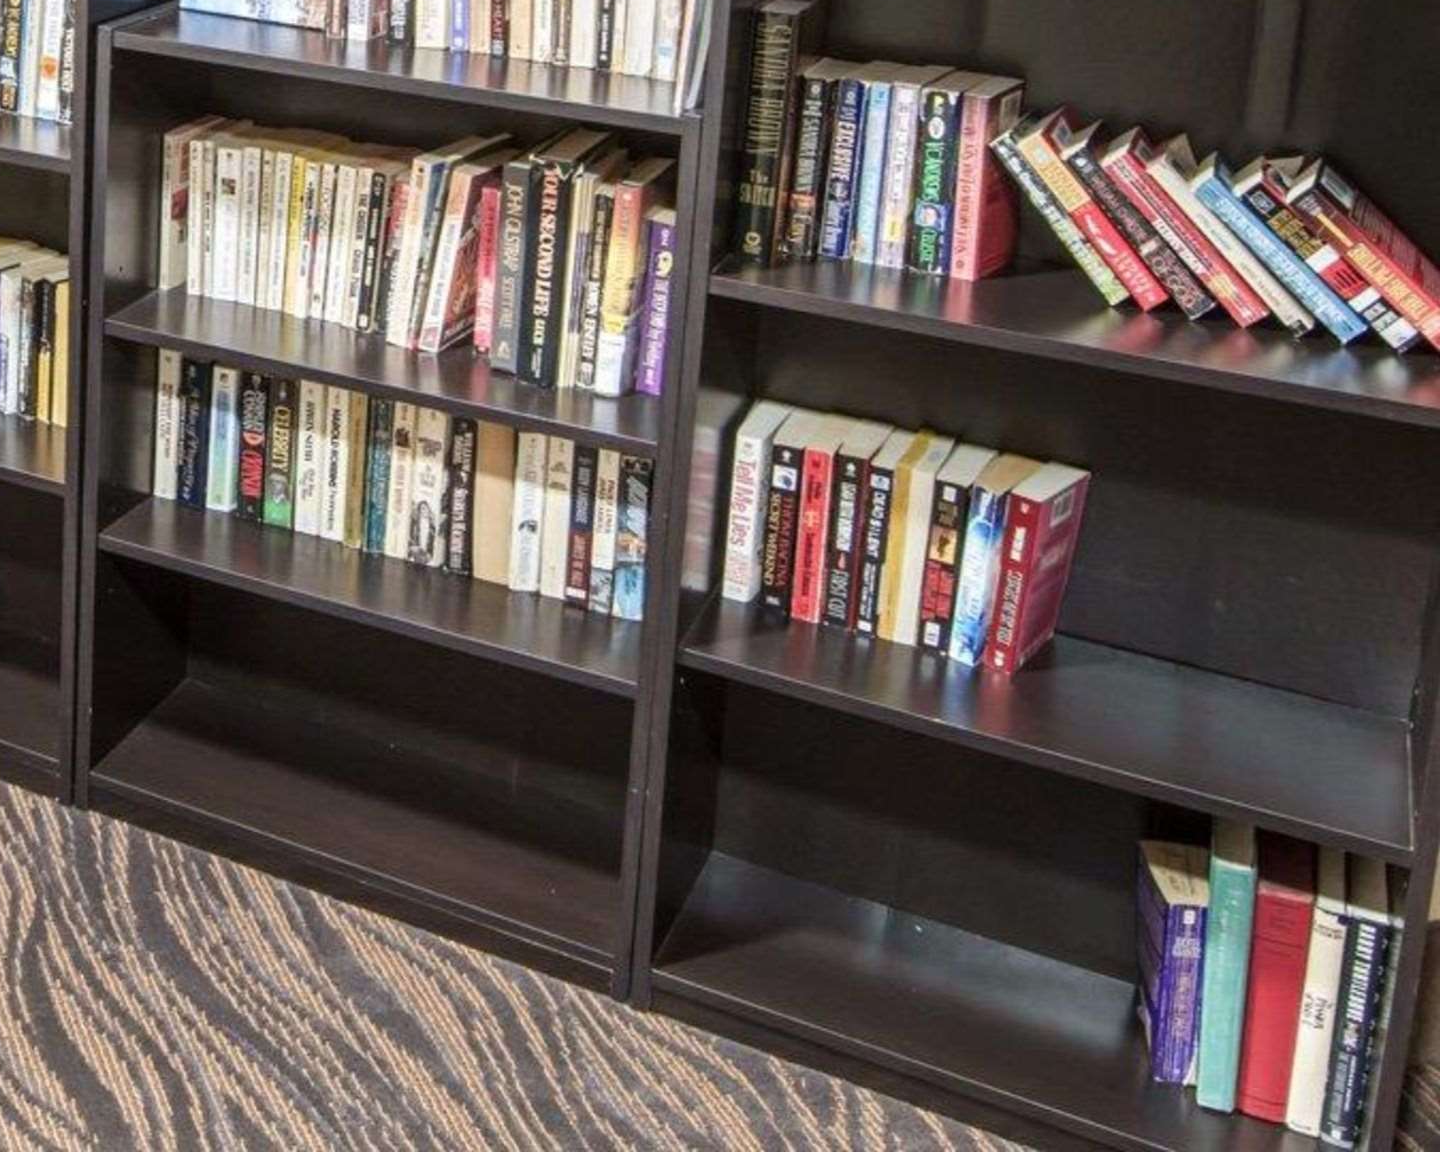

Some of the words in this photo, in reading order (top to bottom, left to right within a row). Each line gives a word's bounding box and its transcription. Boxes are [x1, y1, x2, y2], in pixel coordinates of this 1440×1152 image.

[752, 23, 792, 90] SANDRA
[745, 97, 784, 156] BROWN
[831, 120, 856, 182] EXCLUSIVE
[503, 182, 525, 216] JOHN
[539, 169, 562, 213] YOUR
[533, 211, 557, 279] SECOND
[530, 278, 552, 317] LIFE
[734, 460, 757, 485] Tell
[732, 487, 755, 512] Me
[767, 493, 781, 529] SECRET
[870, 491, 887, 517] DEAD
[729, 514, 752, 547] Lies
[867, 518, 886, 558] SILENT
[762, 532, 778, 586] WEEKEND
[829, 568, 849, 597] FIRST
[828, 598, 848, 620] CUT
